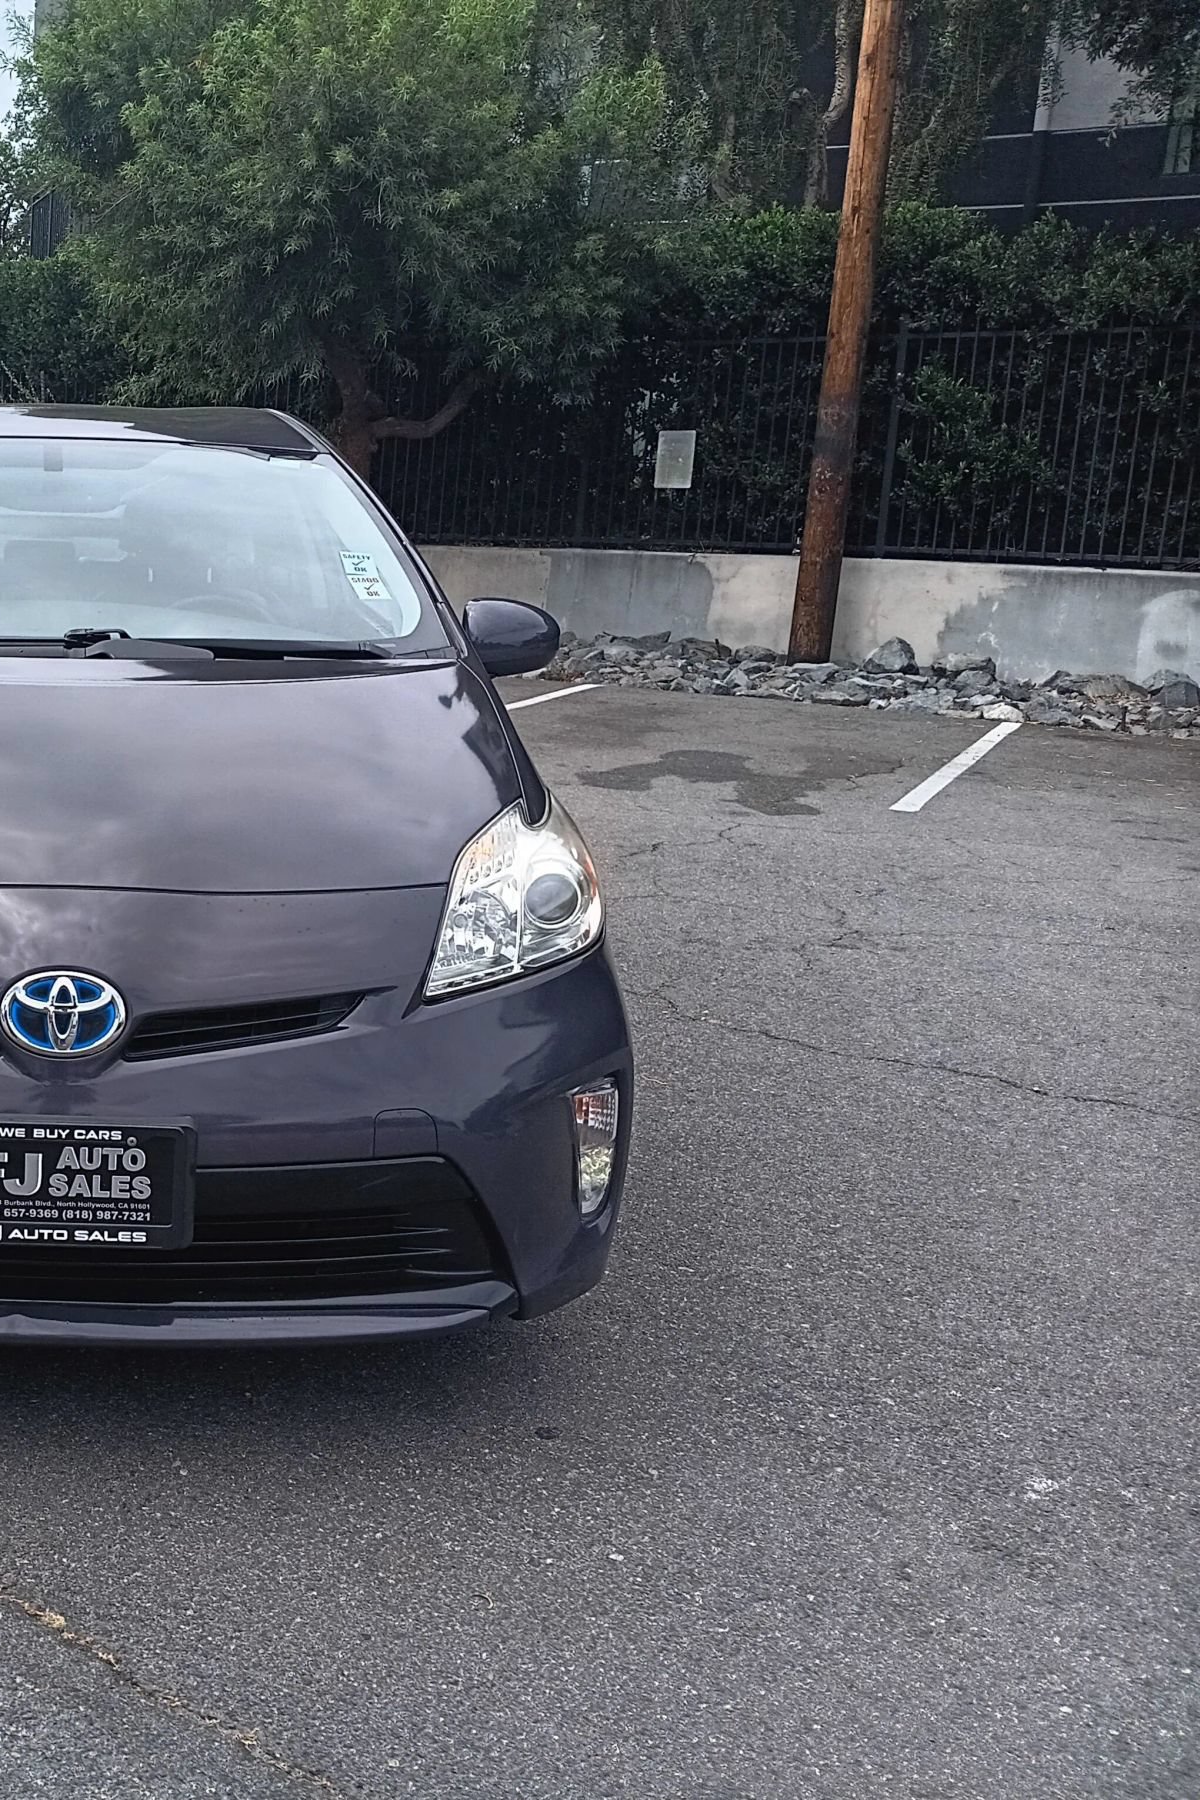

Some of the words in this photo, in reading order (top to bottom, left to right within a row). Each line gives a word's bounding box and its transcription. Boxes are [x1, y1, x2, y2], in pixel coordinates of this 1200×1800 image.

[33, 1128, 70, 1140] BUY
[74, 1129, 122, 1141] CARS
[56, 1146, 146, 1172] AUTO
[48, 1173, 152, 1200] SALES
[56, 1200, 76, 1208] North
[78, 1202, 117, 1210] Hollywood,
[4, 1208, 59, 1218] 657-9369
[62, 1210, 93, 1220] (818)
[96, 1210, 151, 1222] 987-7321
[7, 1228, 68, 1242] AUTO
[73, 1230, 147, 1244] SALES
